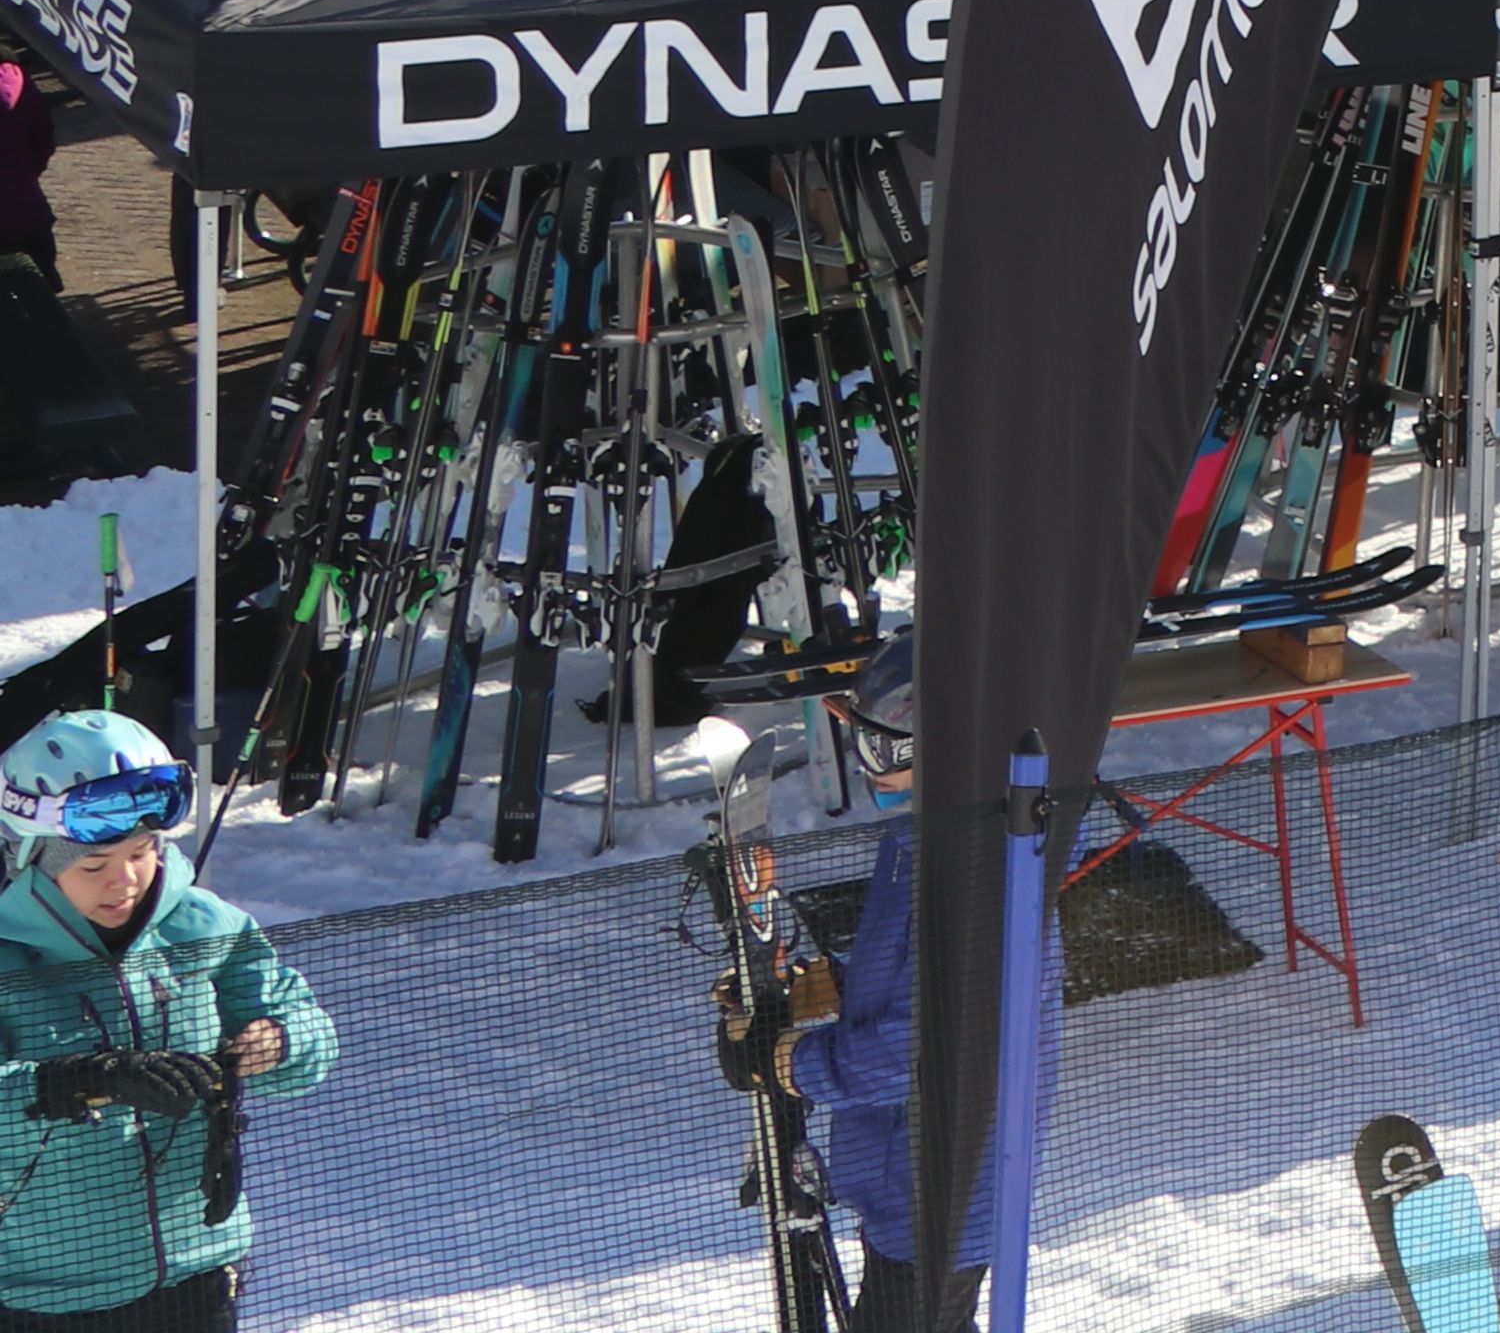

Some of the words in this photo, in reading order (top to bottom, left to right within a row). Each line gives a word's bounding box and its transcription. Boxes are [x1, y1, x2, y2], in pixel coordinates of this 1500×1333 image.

[1401, 83, 1433, 156] LINE
[396, 200, 420, 268] DYNASTAR
[577, 185, 597, 256] DYNASTAR
[877, 168, 914, 244] DYNASTAR
